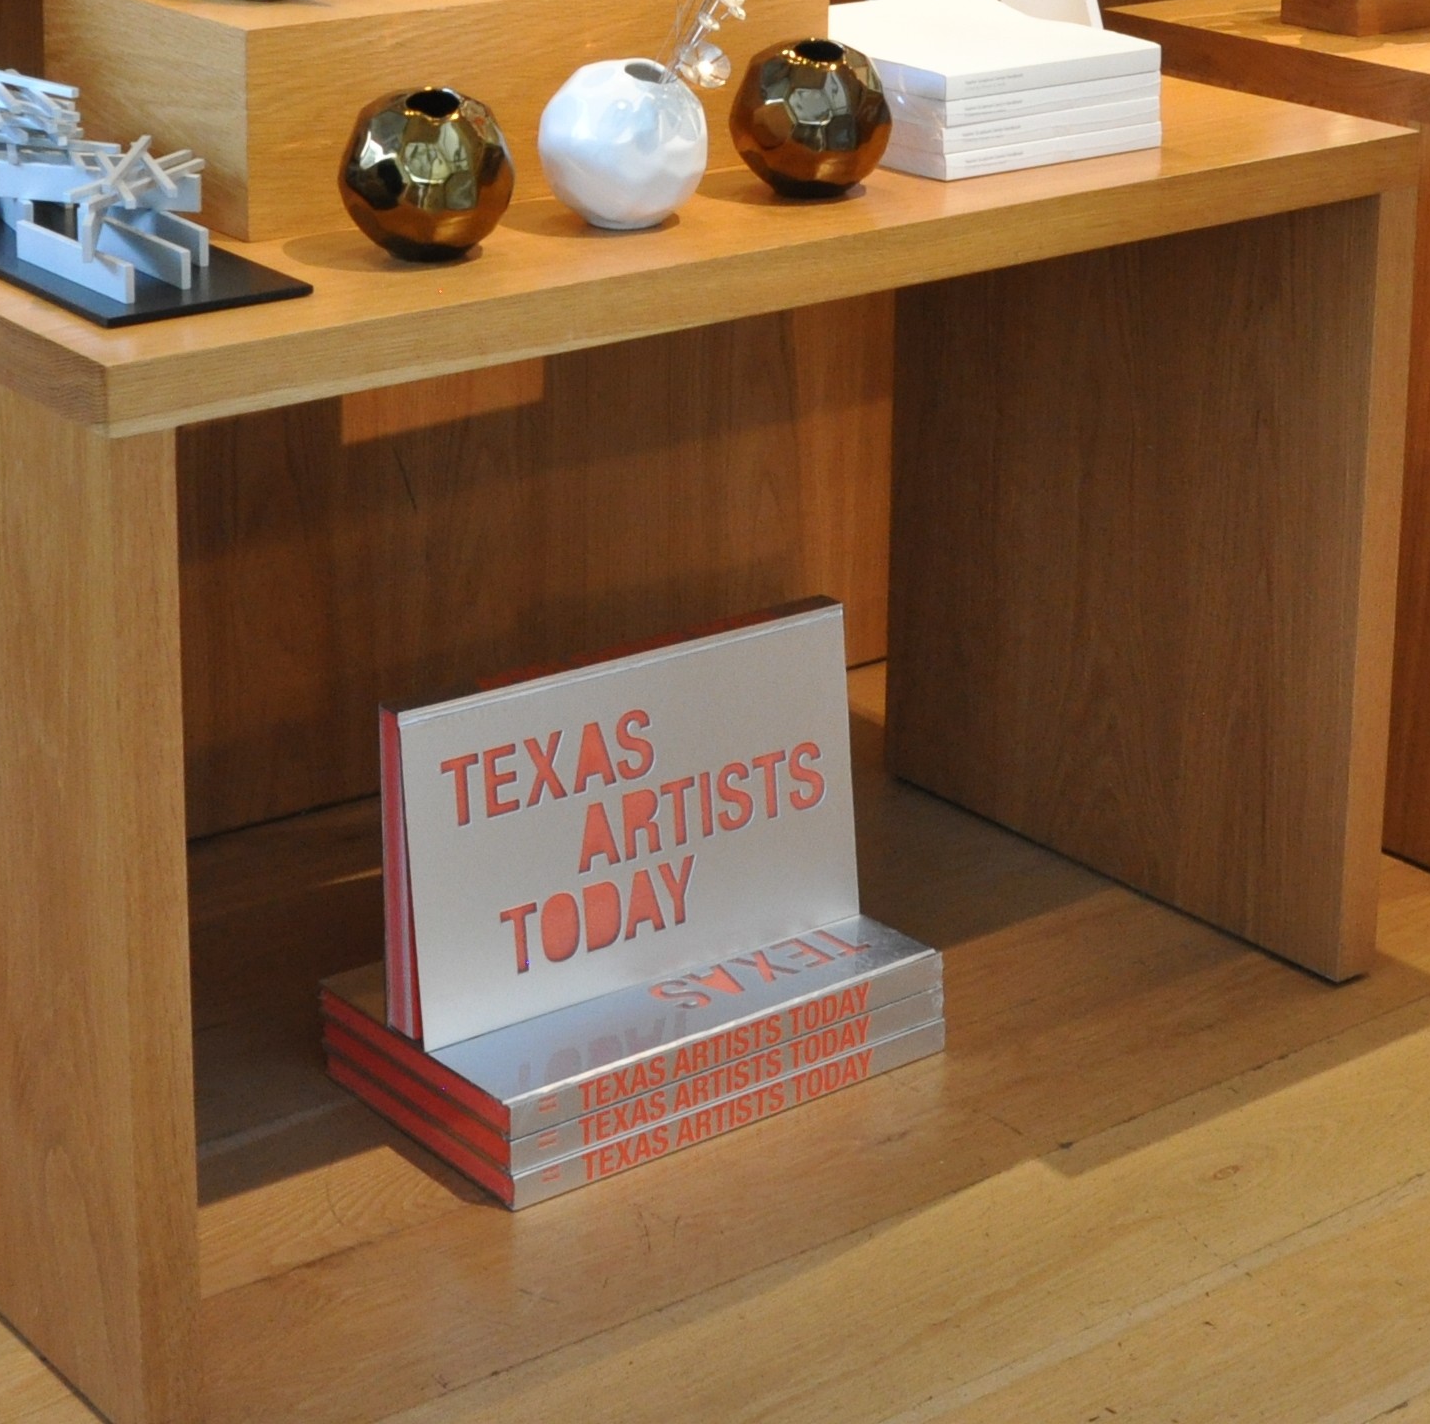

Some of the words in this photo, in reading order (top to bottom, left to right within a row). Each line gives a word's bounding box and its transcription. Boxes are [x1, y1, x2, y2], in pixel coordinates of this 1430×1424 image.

[440, 708, 657, 827] TEXAS
[577, 740, 826, 874] ARTISTS
[498, 853, 696, 975] TODAY
[648, 929, 872, 1010] TEXAS
[577, 1090, 667, 1146] TEXAS
[672, 1049, 783, 1113] ARTISTS
[788, 1015, 871, 1069] TODAY
[578, 1056, 667, 1111] TEXAS
[672, 1014, 782, 1077] ARTISTS
[788, 981, 871, 1033] TODAY
[581, 1127, 670, 1181] TEXAS
[675, 1082, 786, 1148] ARTISTS
[793, 1048, 874, 1104] TODAY
